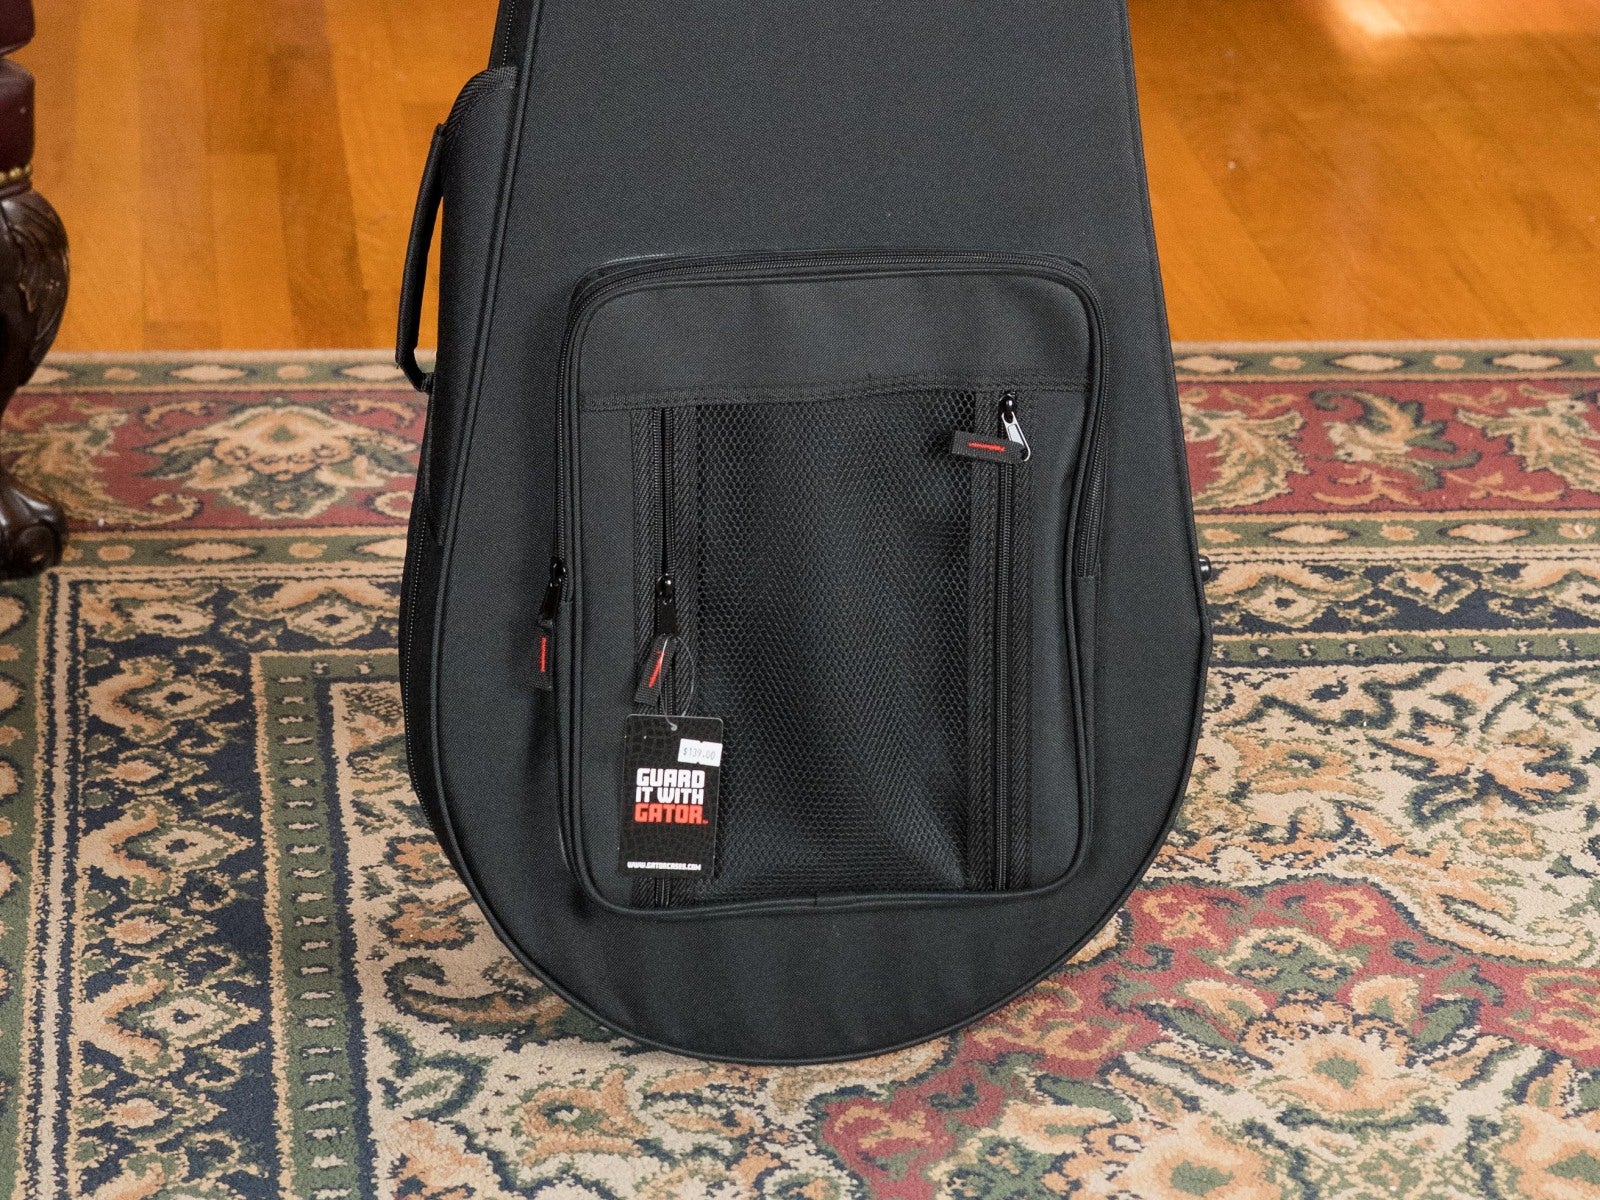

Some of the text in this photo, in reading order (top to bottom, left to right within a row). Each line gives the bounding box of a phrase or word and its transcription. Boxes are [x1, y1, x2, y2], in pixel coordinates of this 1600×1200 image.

[636, 767, 706, 789] GUARD
[636, 786, 704, 805] IT WITH
